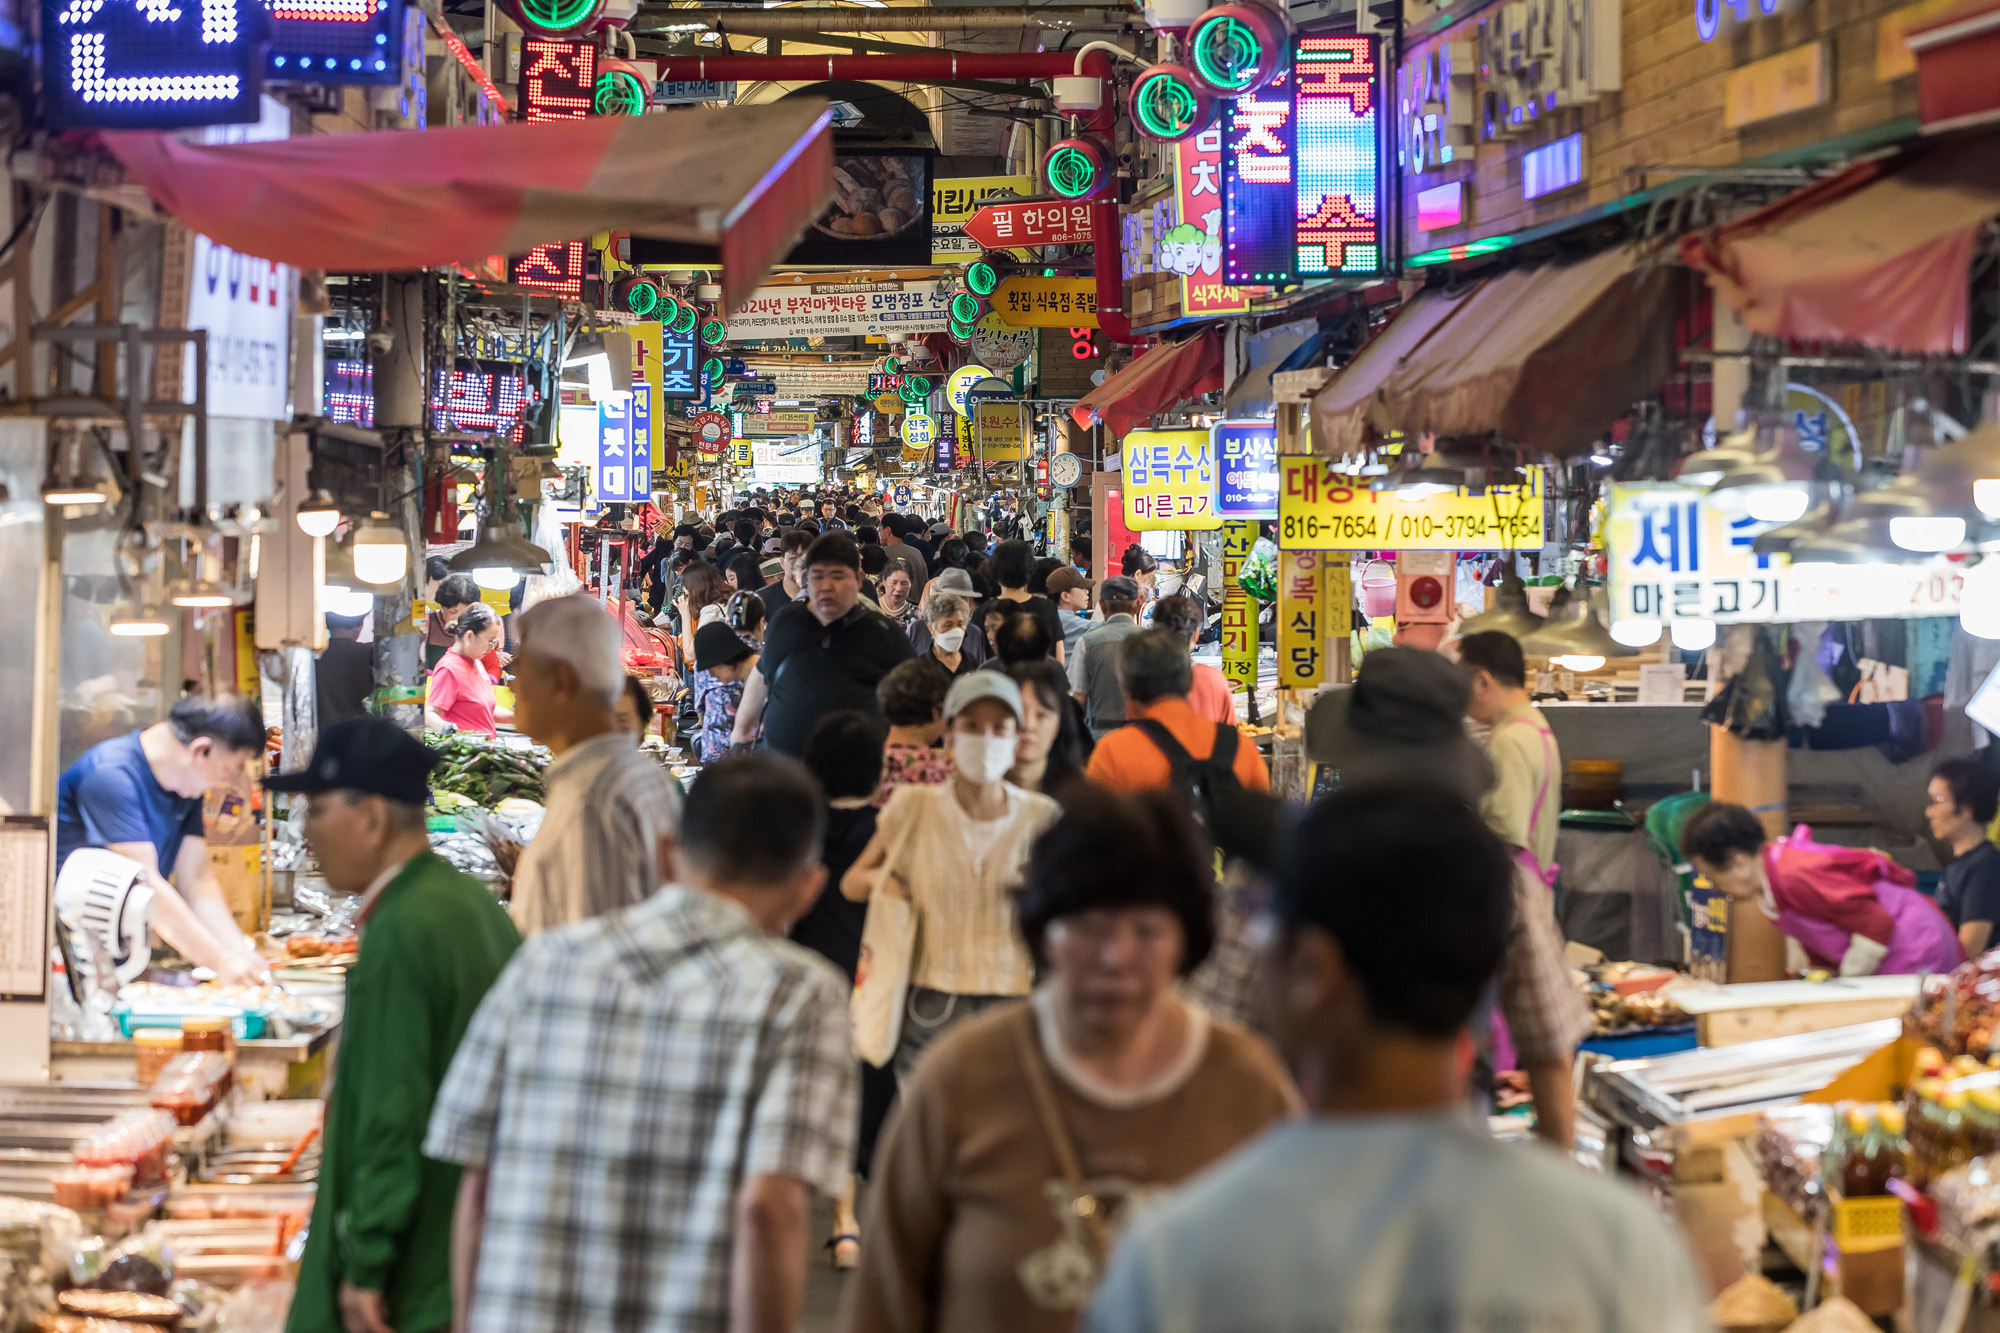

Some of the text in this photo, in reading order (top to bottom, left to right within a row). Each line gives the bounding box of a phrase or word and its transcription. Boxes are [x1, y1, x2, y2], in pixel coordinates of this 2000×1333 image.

[992, 205, 1092, 237] 필 한의원
[1051, 232, 1092, 242] 806-1075
[732, 298, 782, 316] 024년
[787, 294, 866, 315] 부전마켓타운
[872, 292, 923, 311] 모범점포
[908, 419, 928, 430] 진주
[908, 432, 929, 443] 상회
[1284, 515, 1376, 539] 816-7654
[1401, 515, 1540, 539] 010-3794-7654
[1632, 578, 1780, 618] 마른고기
